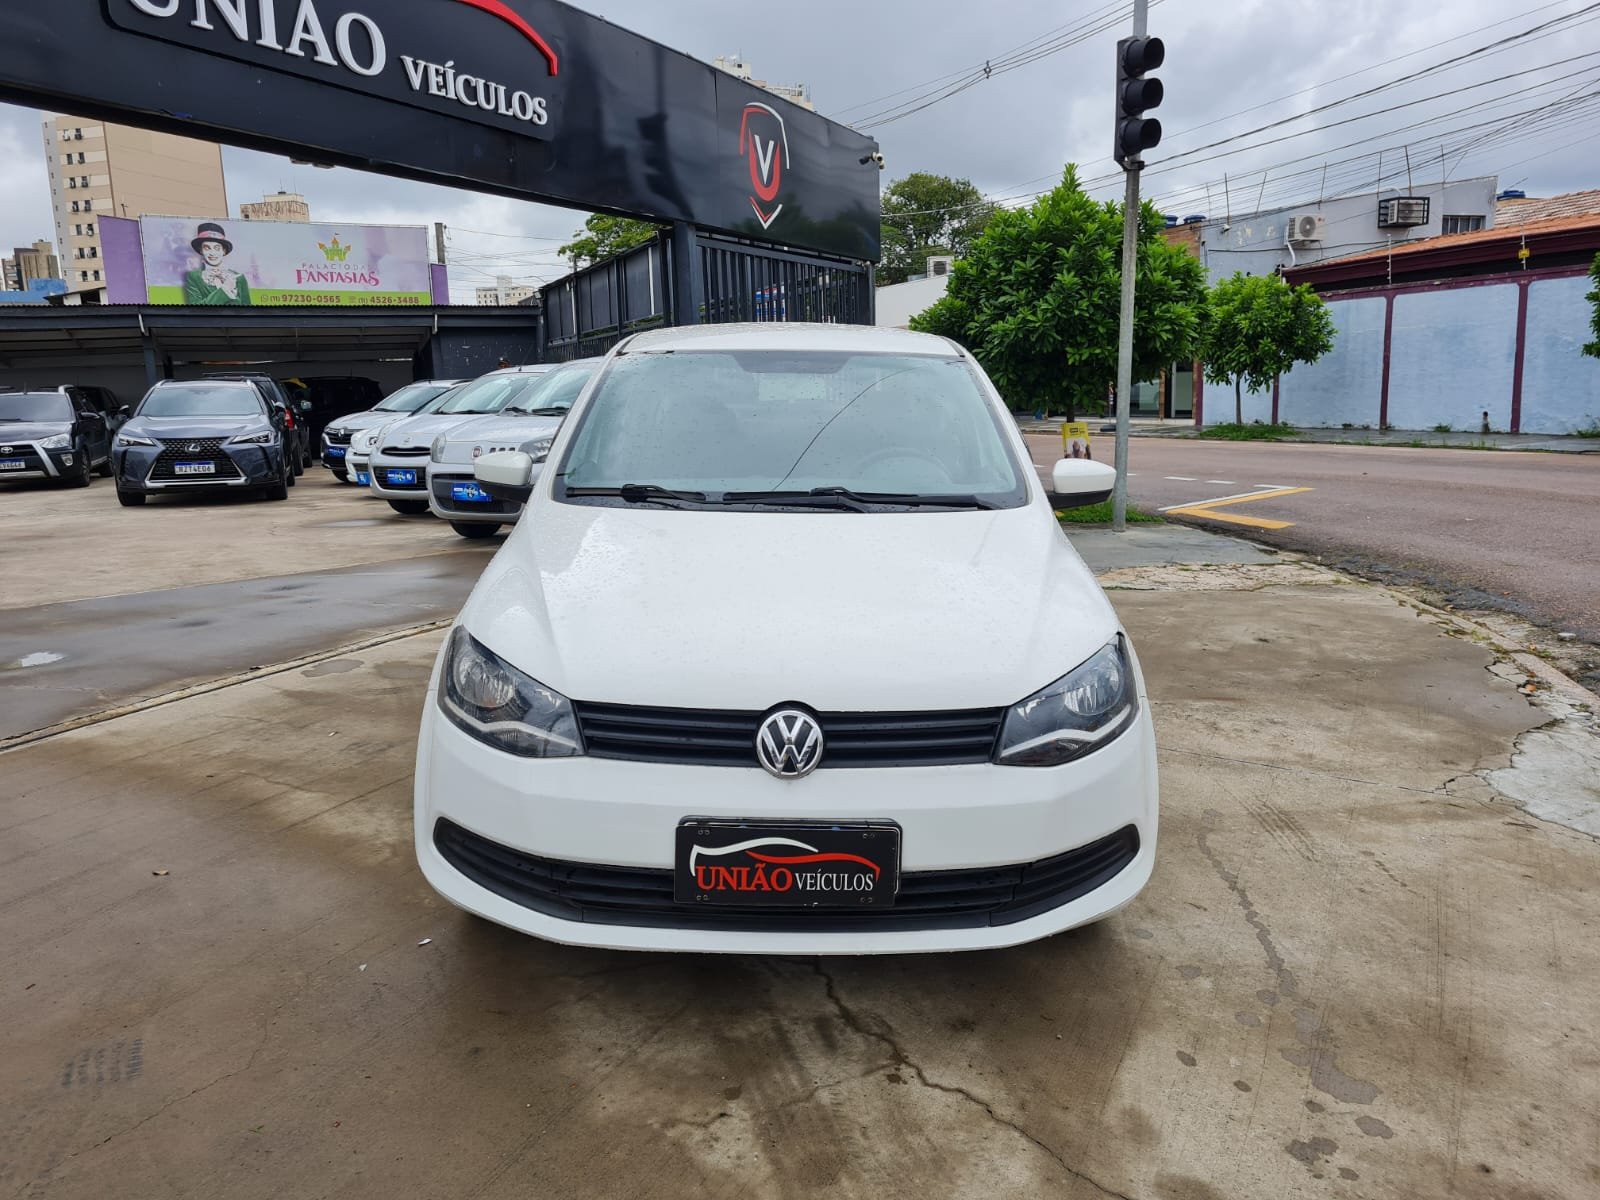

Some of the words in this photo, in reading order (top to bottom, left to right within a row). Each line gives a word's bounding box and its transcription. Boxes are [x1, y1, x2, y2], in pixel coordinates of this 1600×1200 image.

[401, 55, 549, 126] VEÍCULOS
[296, 269, 380, 287] FANTASIAS
[282, 295, 341, 303] 97230-0565
[696, 864, 793, 892] UNIÃO
[795, 869, 874, 892] VEÍCULOS
